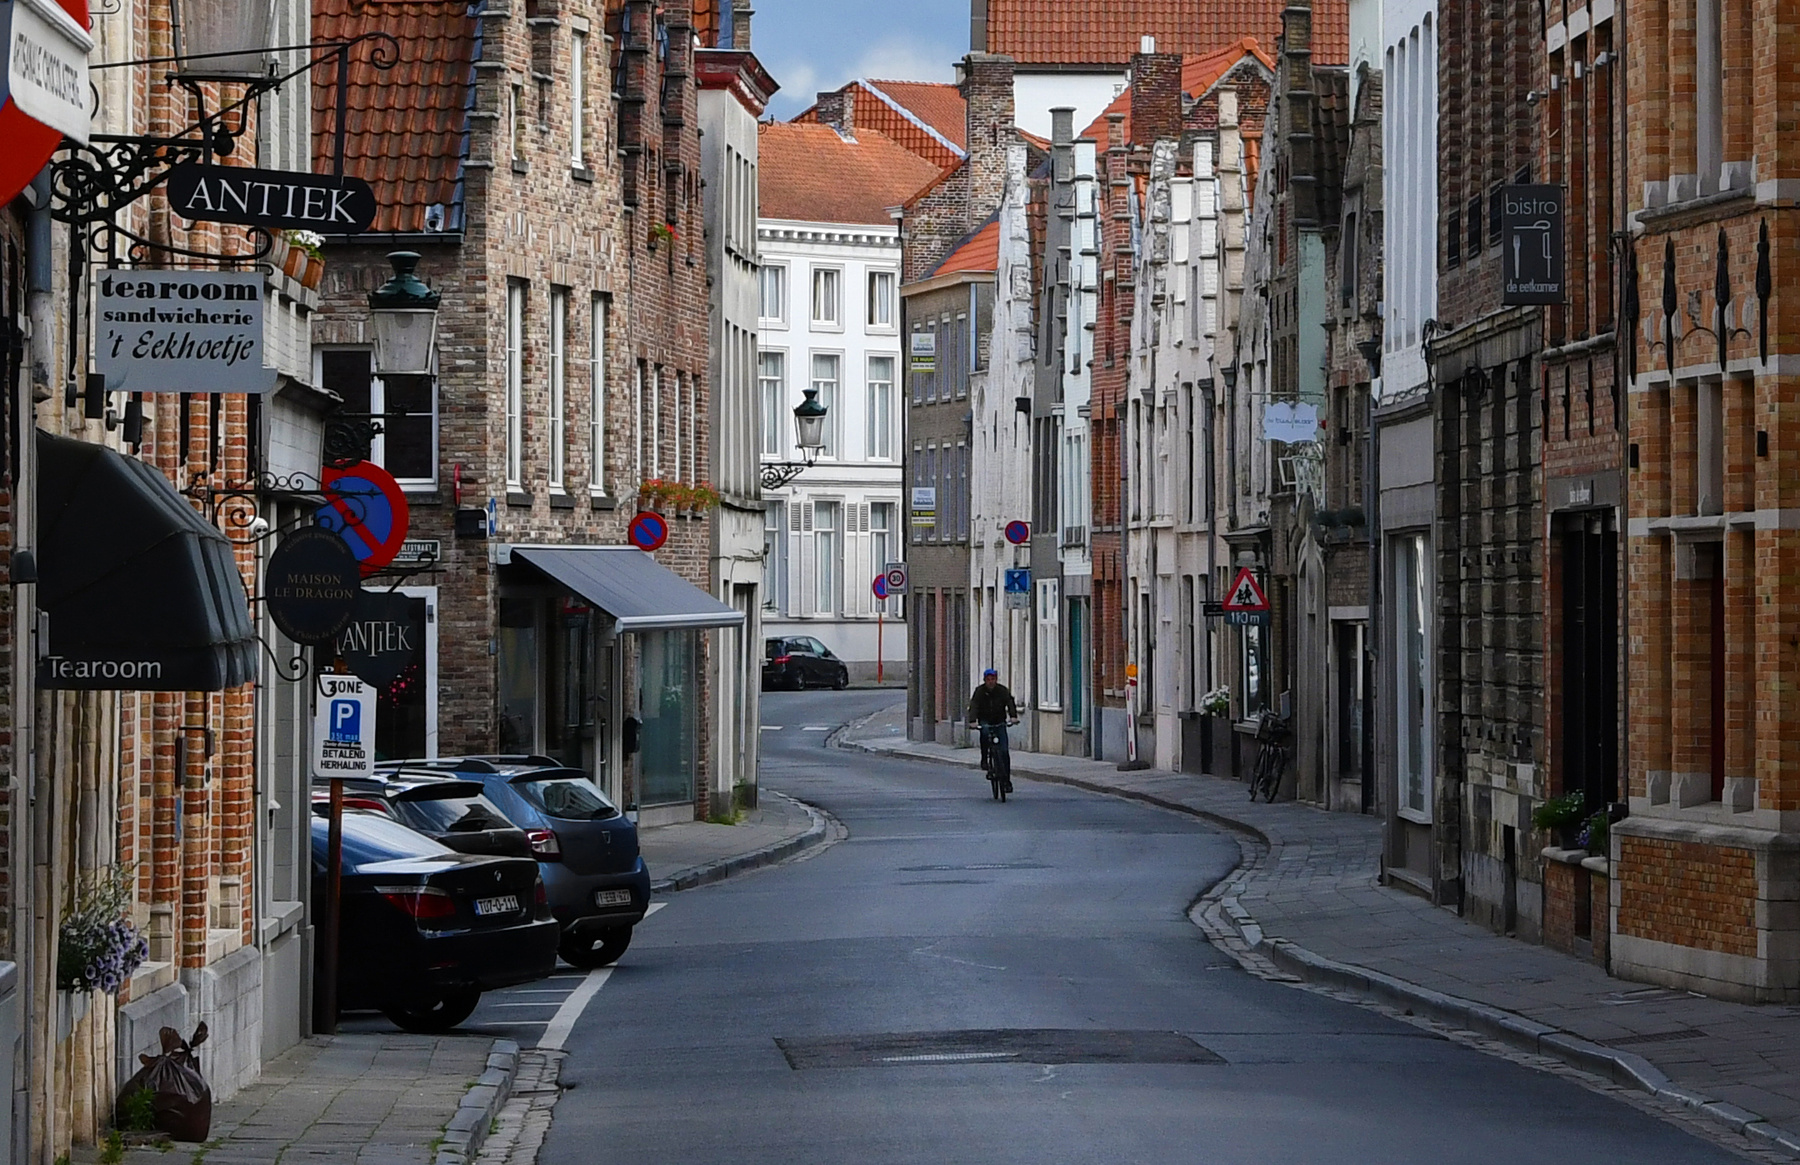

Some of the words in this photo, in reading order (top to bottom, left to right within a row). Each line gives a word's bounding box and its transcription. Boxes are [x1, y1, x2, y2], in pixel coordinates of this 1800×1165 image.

[185, 177, 357, 224] ANTIEK
[1506, 193, 1558, 215] bistro
[101, 273, 259, 301] tearoom
[1506, 278, 1518, 292] de
[1519, 278, 1560, 292] eetkamer
[103, 307, 254, 325] sandwicherie
[107, 330, 124, 359] 't
[132, 330, 254, 366] Eekhoetje
[287, 574, 341, 585] MAISON
[274, 587, 290, 598] LE
[295, 587, 353, 599] DRAGON
[47, 656, 161, 678] Tearoom
[336, 703, 354, 729] P
[322, 749, 366, 759] BETALEND
[320, 760, 367, 770] HERHALING
